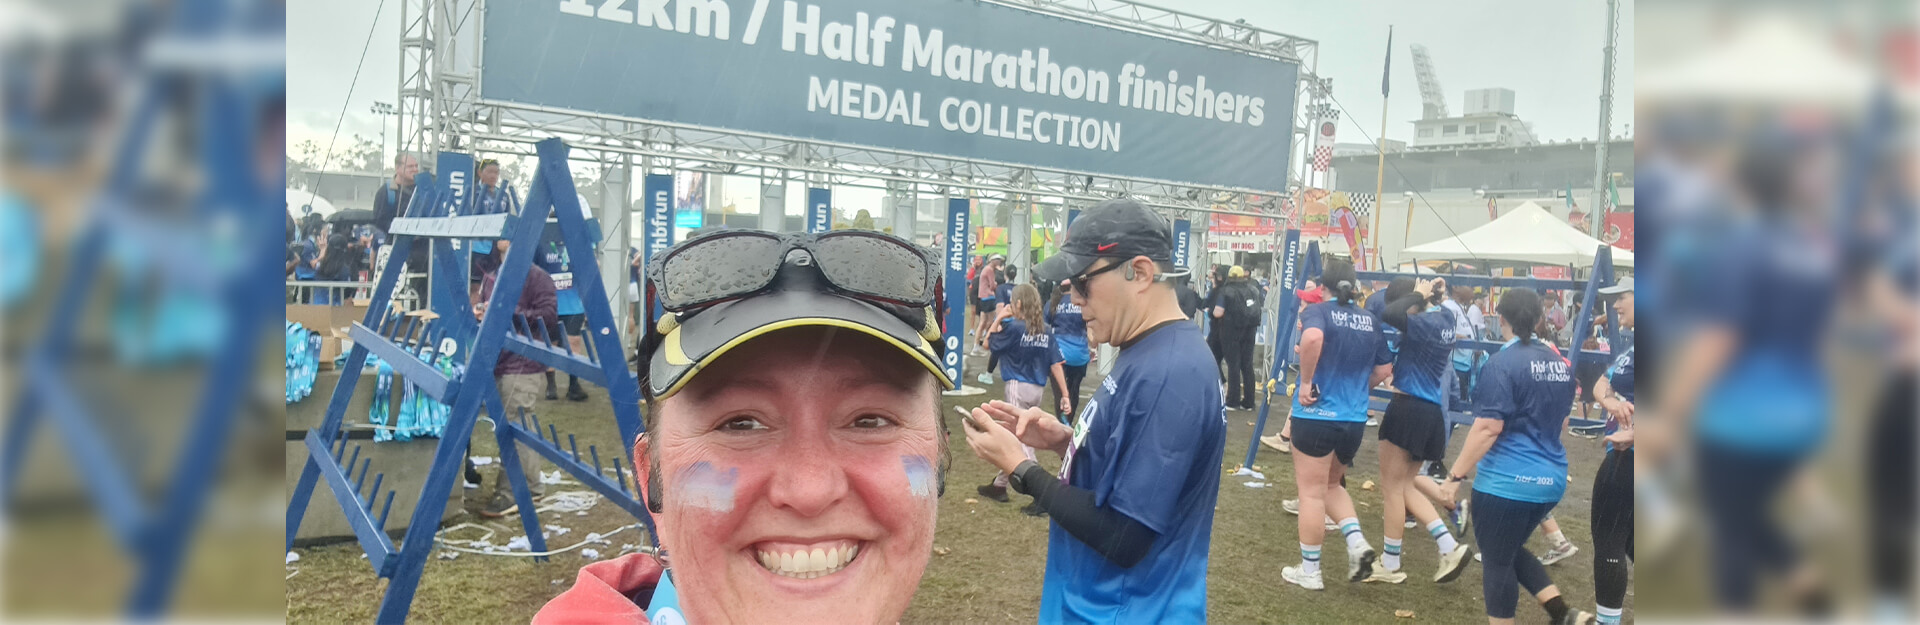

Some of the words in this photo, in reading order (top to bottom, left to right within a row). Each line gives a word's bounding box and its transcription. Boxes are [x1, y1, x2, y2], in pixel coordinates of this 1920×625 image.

[782, 0, 896, 67] Half
[901, 24, 1109, 103] Marathon
[1118, 63, 1265, 127] finishers
[807, 76, 930, 127] MEDAL
[939, 97, 1121, 152] COLLECTION
[651, 190, 668, 253] hbfrun
[951, 212, 965, 271] #hbfrun
[1175, 231, 1186, 266] bfrun
[1284, 241, 1296, 290] #hbfrun
